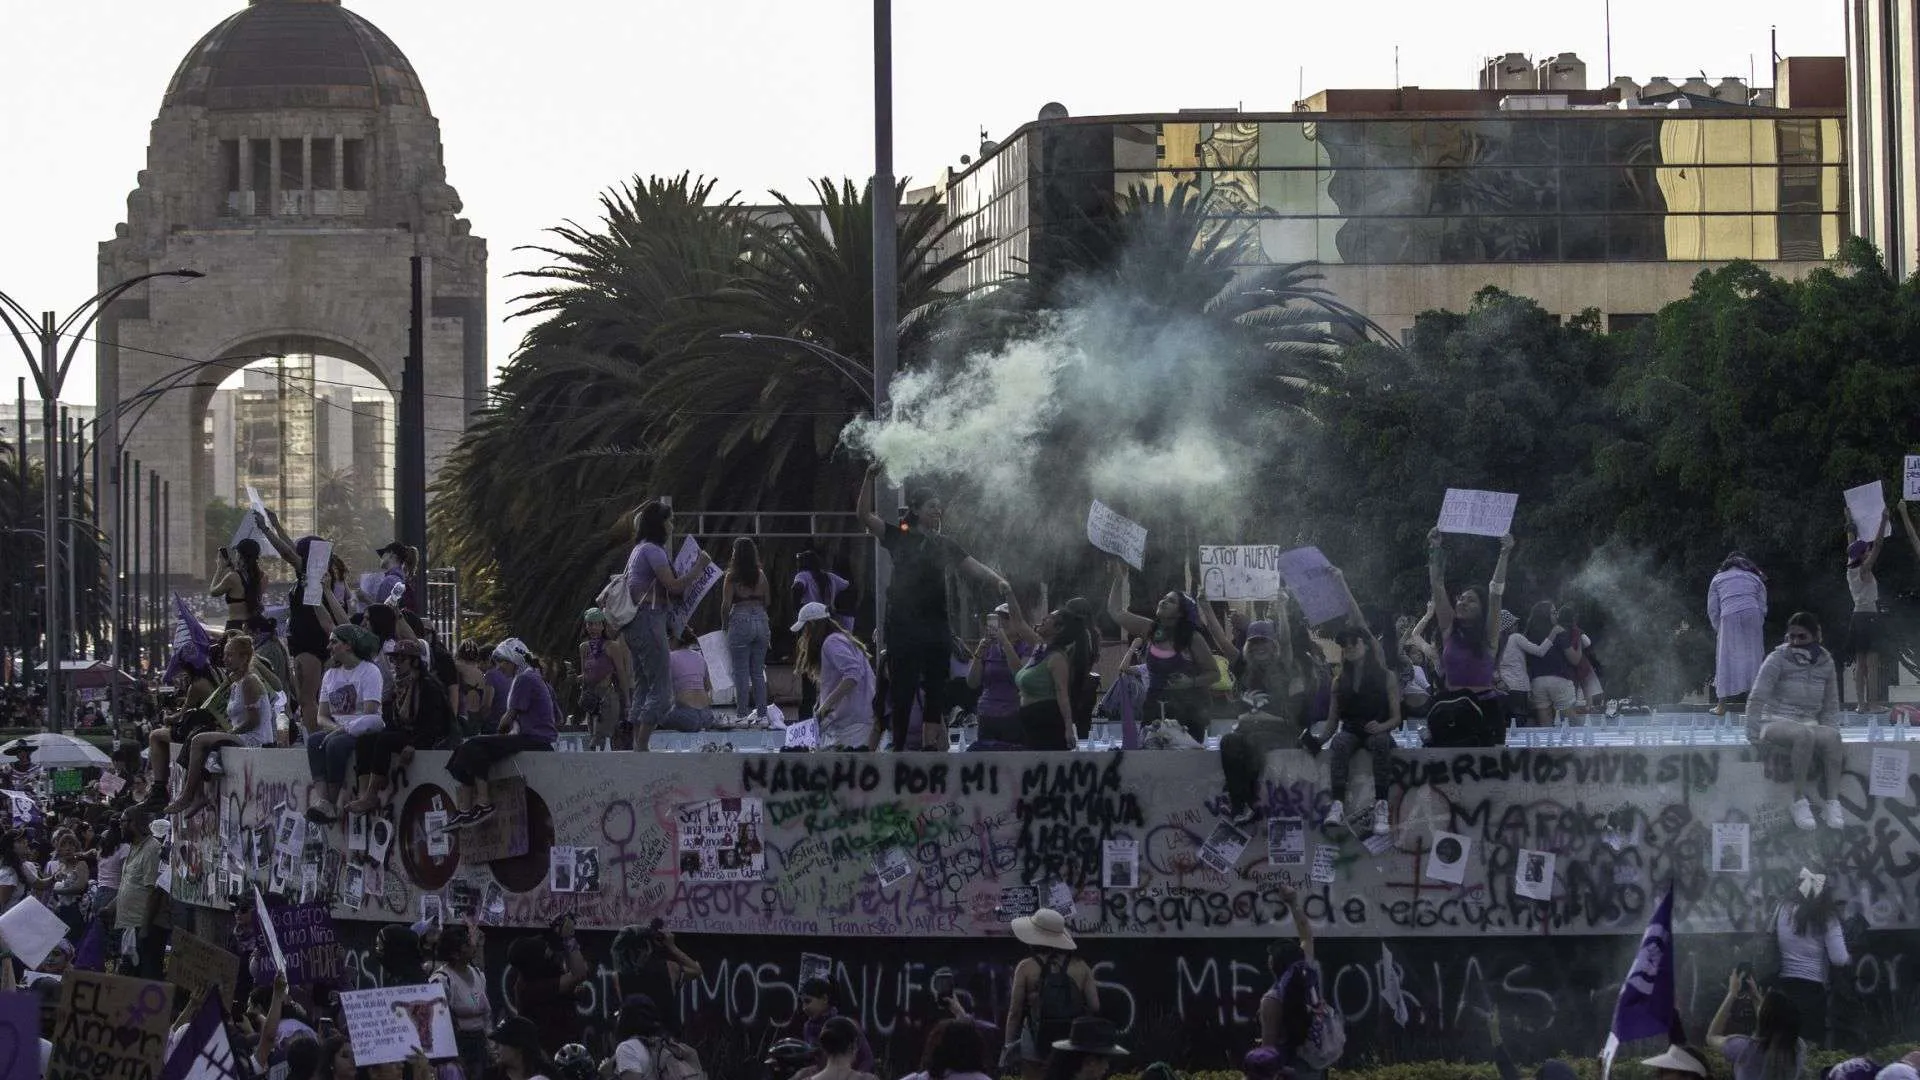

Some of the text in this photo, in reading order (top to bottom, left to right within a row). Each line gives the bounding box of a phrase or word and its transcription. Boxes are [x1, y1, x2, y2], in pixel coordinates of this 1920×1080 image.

[742, 757, 881, 795] MARCHO
[894, 763, 948, 795] POR
[959, 762, 999, 795] MI
[71, 980, 110, 1019] EL
